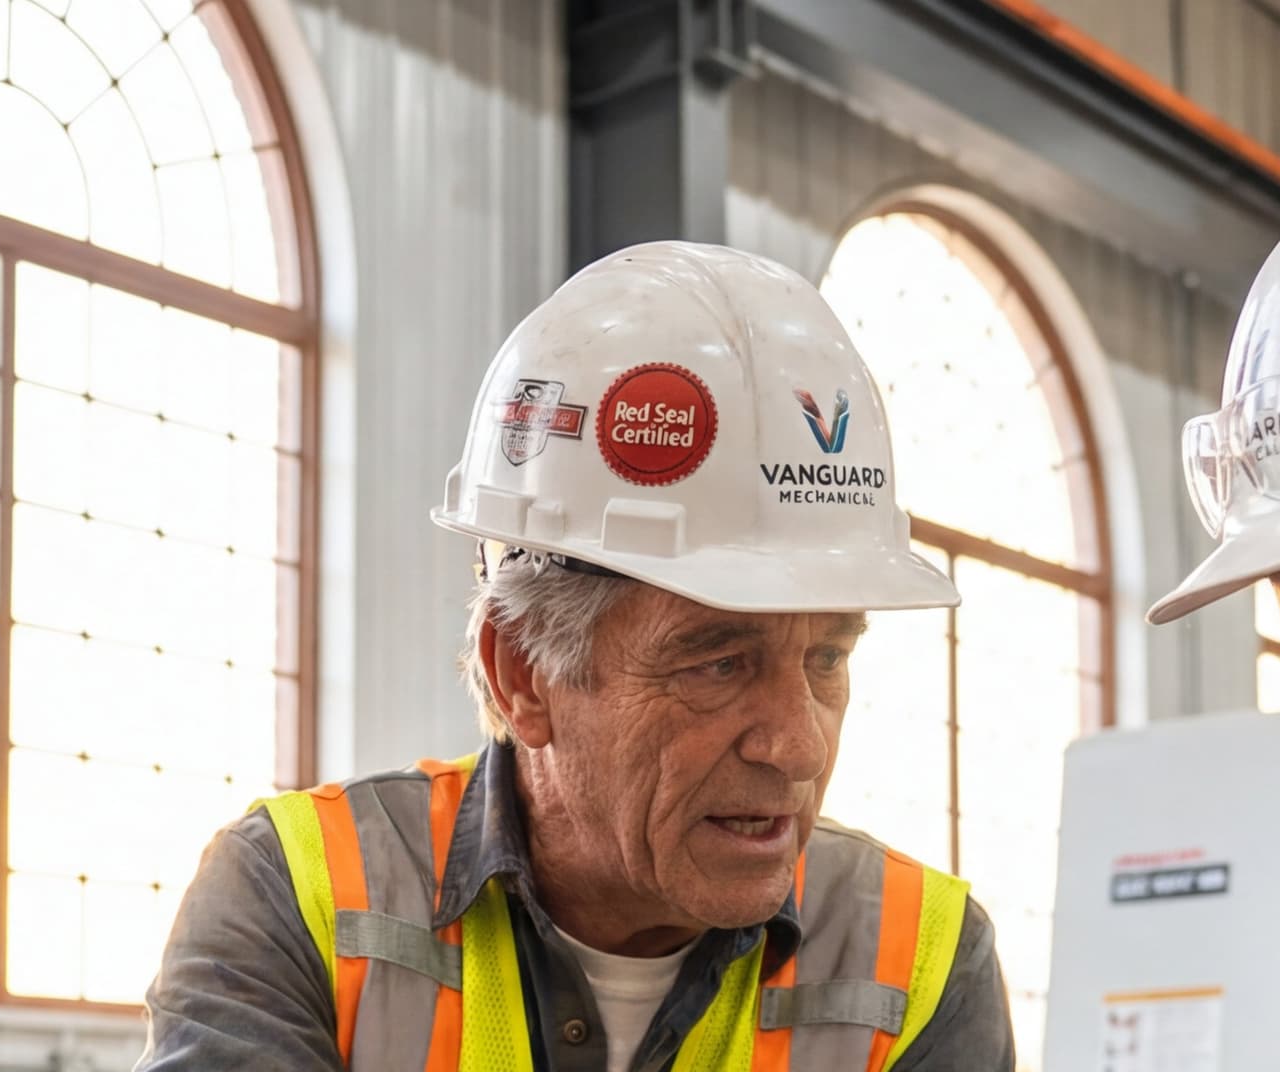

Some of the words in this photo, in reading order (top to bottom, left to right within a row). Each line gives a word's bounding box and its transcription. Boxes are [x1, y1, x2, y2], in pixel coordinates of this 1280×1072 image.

[614, 401, 650, 422] Red
[653, 403, 695, 426] Seal
[760, 463, 886, 488] VANGUARD
